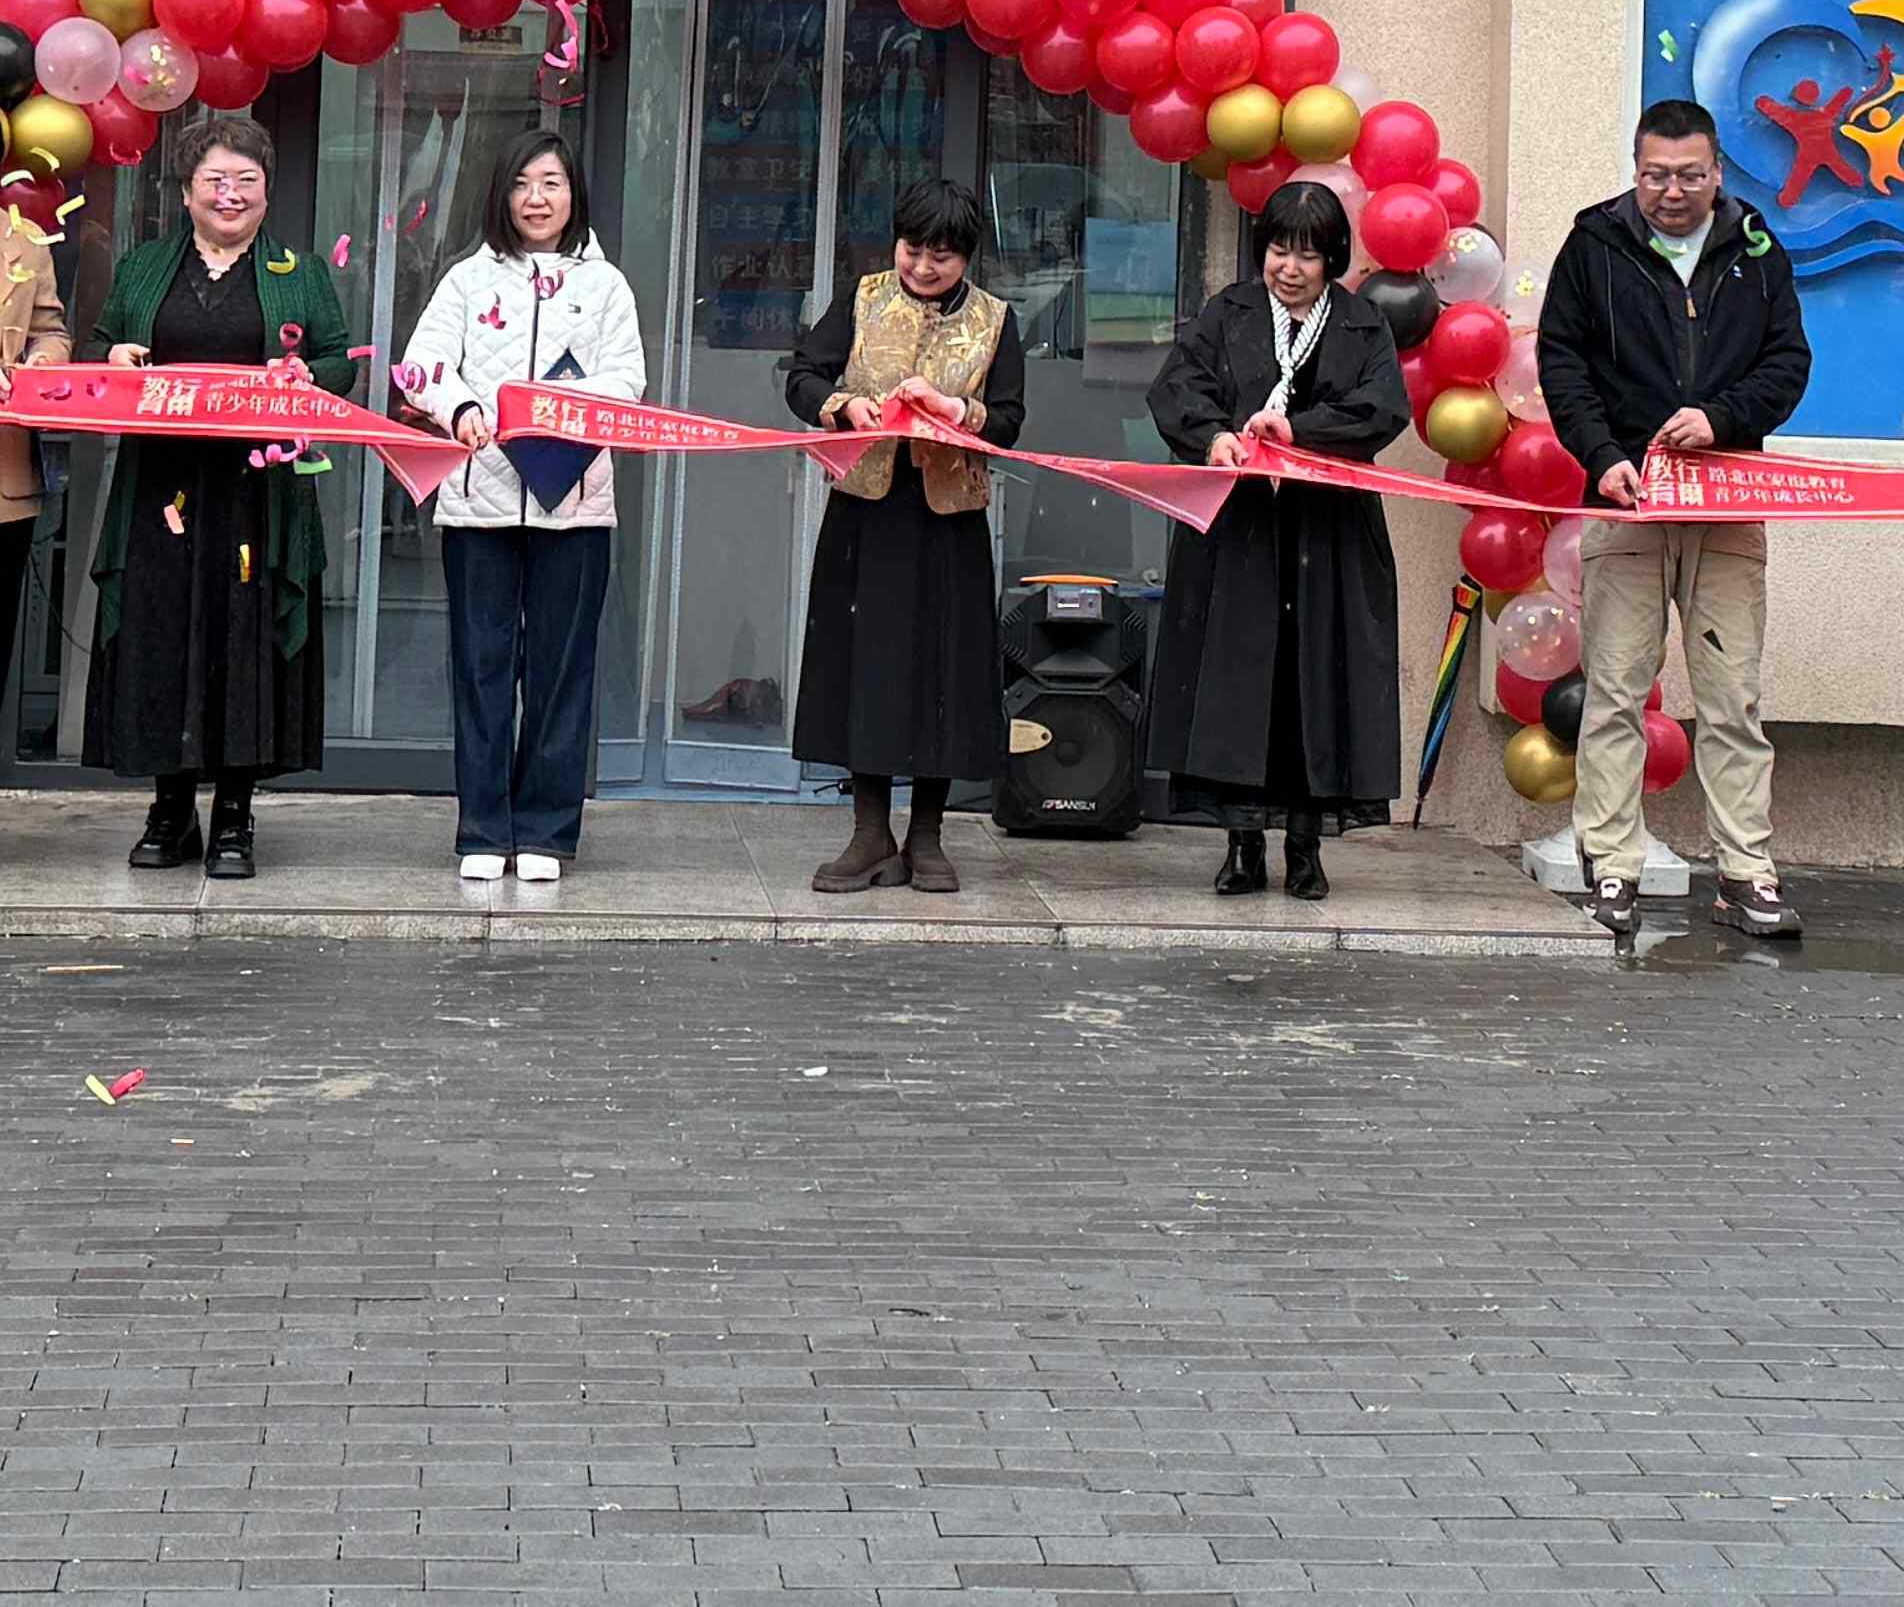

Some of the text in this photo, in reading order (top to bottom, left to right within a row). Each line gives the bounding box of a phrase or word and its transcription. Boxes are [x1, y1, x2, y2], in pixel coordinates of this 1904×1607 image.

[204, 392, 352, 418] 青少年成长中心
